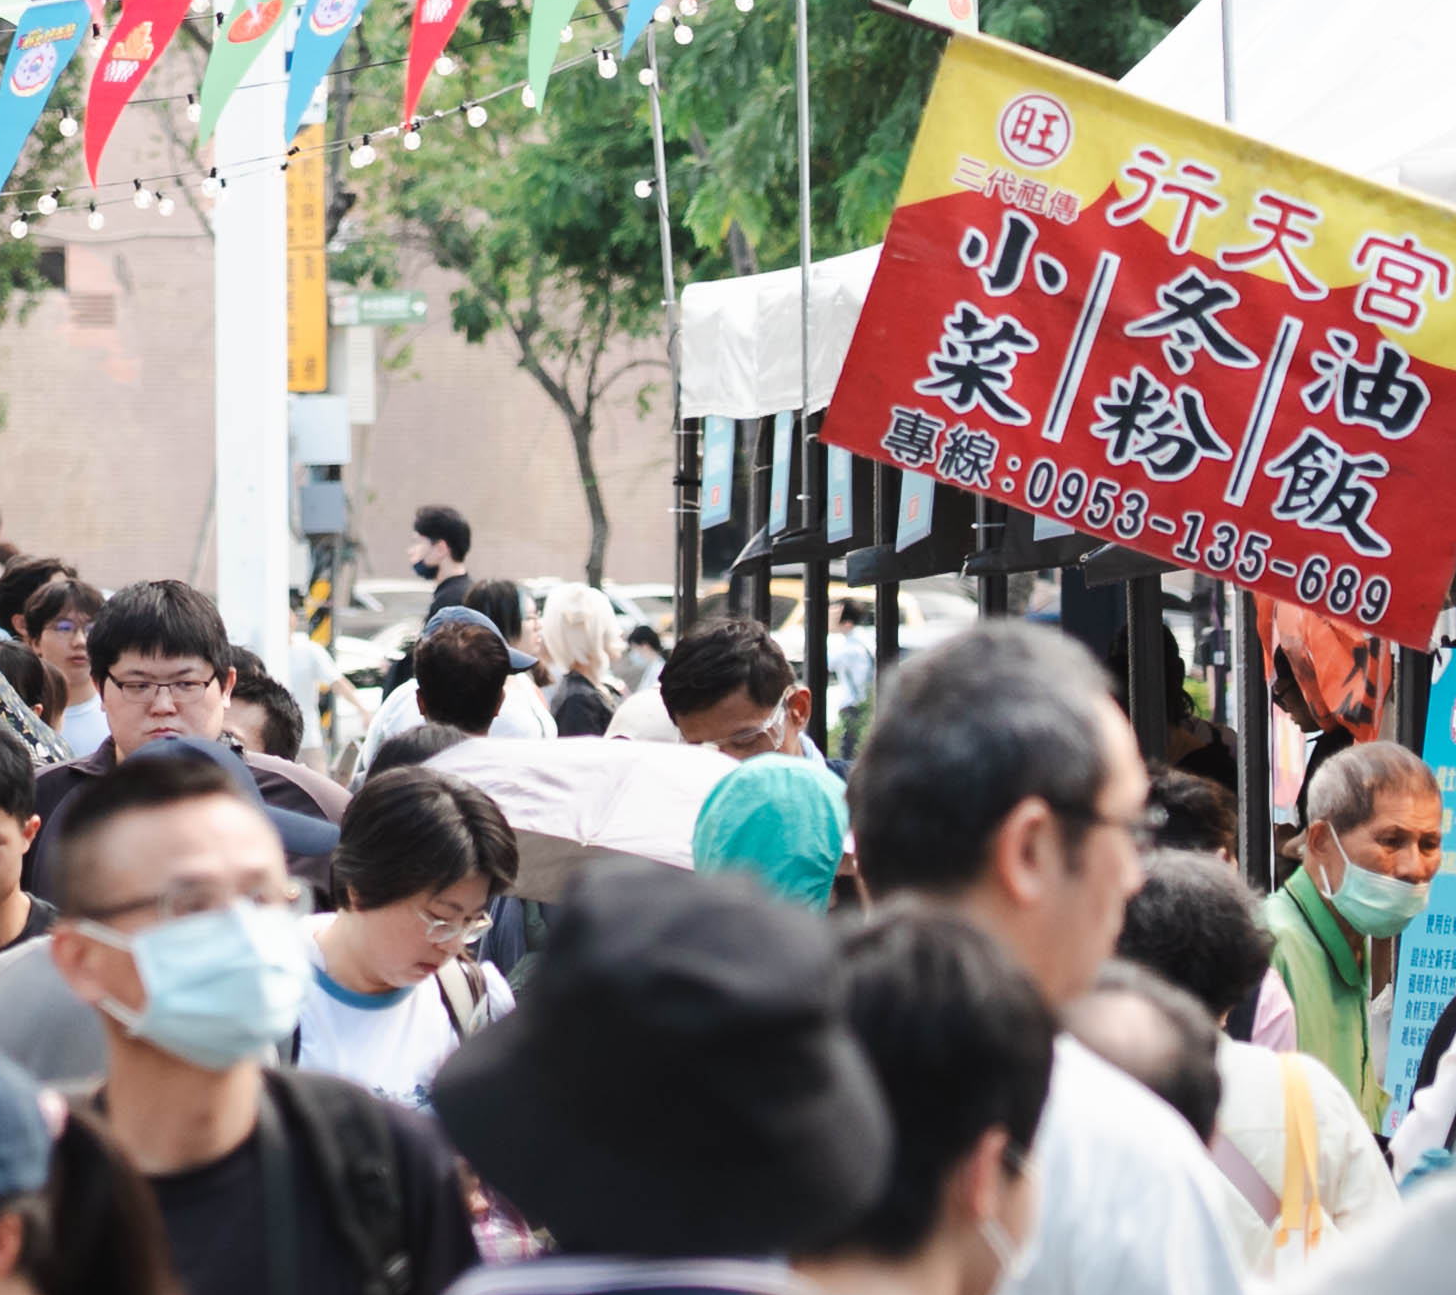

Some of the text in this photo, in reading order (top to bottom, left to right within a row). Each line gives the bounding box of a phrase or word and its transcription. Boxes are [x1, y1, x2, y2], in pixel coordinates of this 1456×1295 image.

[952, 155, 1079, 225] 三代祖傳
[1010, 104, 1060, 157] 旺
[913, 214, 1068, 427] 小菜
[1105, 147, 1454, 334] 行天宮
[1091, 272, 1260, 483] 冬粉
[1264, 328, 1431, 560] 油飯
